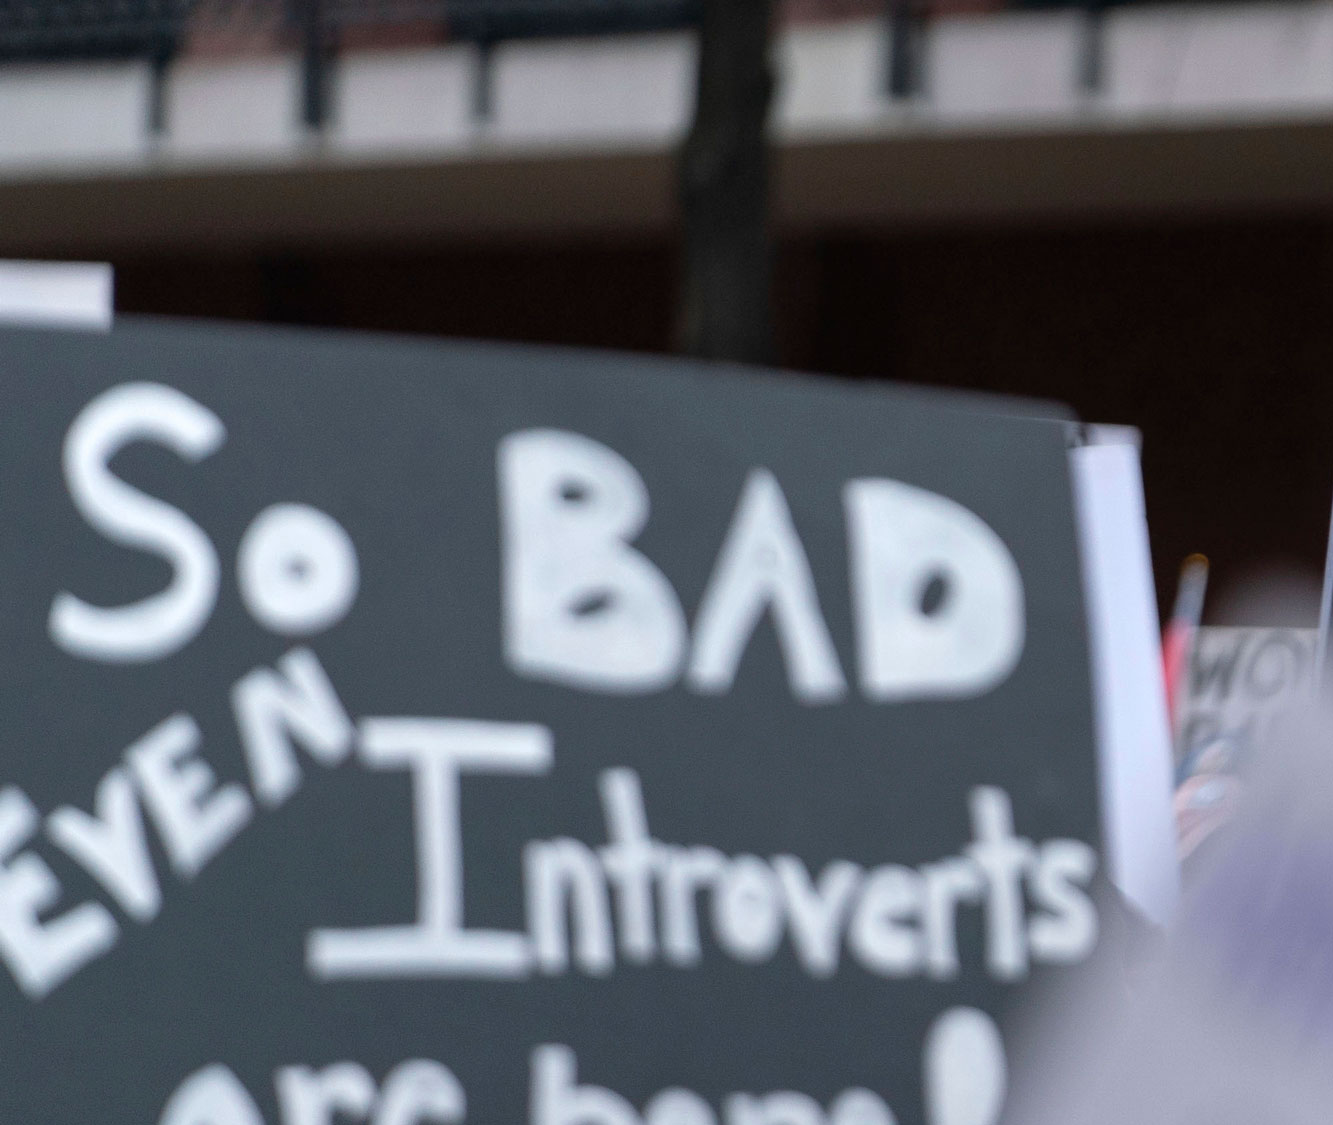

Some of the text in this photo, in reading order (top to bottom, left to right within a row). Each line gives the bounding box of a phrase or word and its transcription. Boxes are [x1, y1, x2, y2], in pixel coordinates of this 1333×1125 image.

[49, 380, 1026, 703] So BAD
[0, 647, 358, 1000] EVEN
[308, 715, 1098, 981] Introverts
